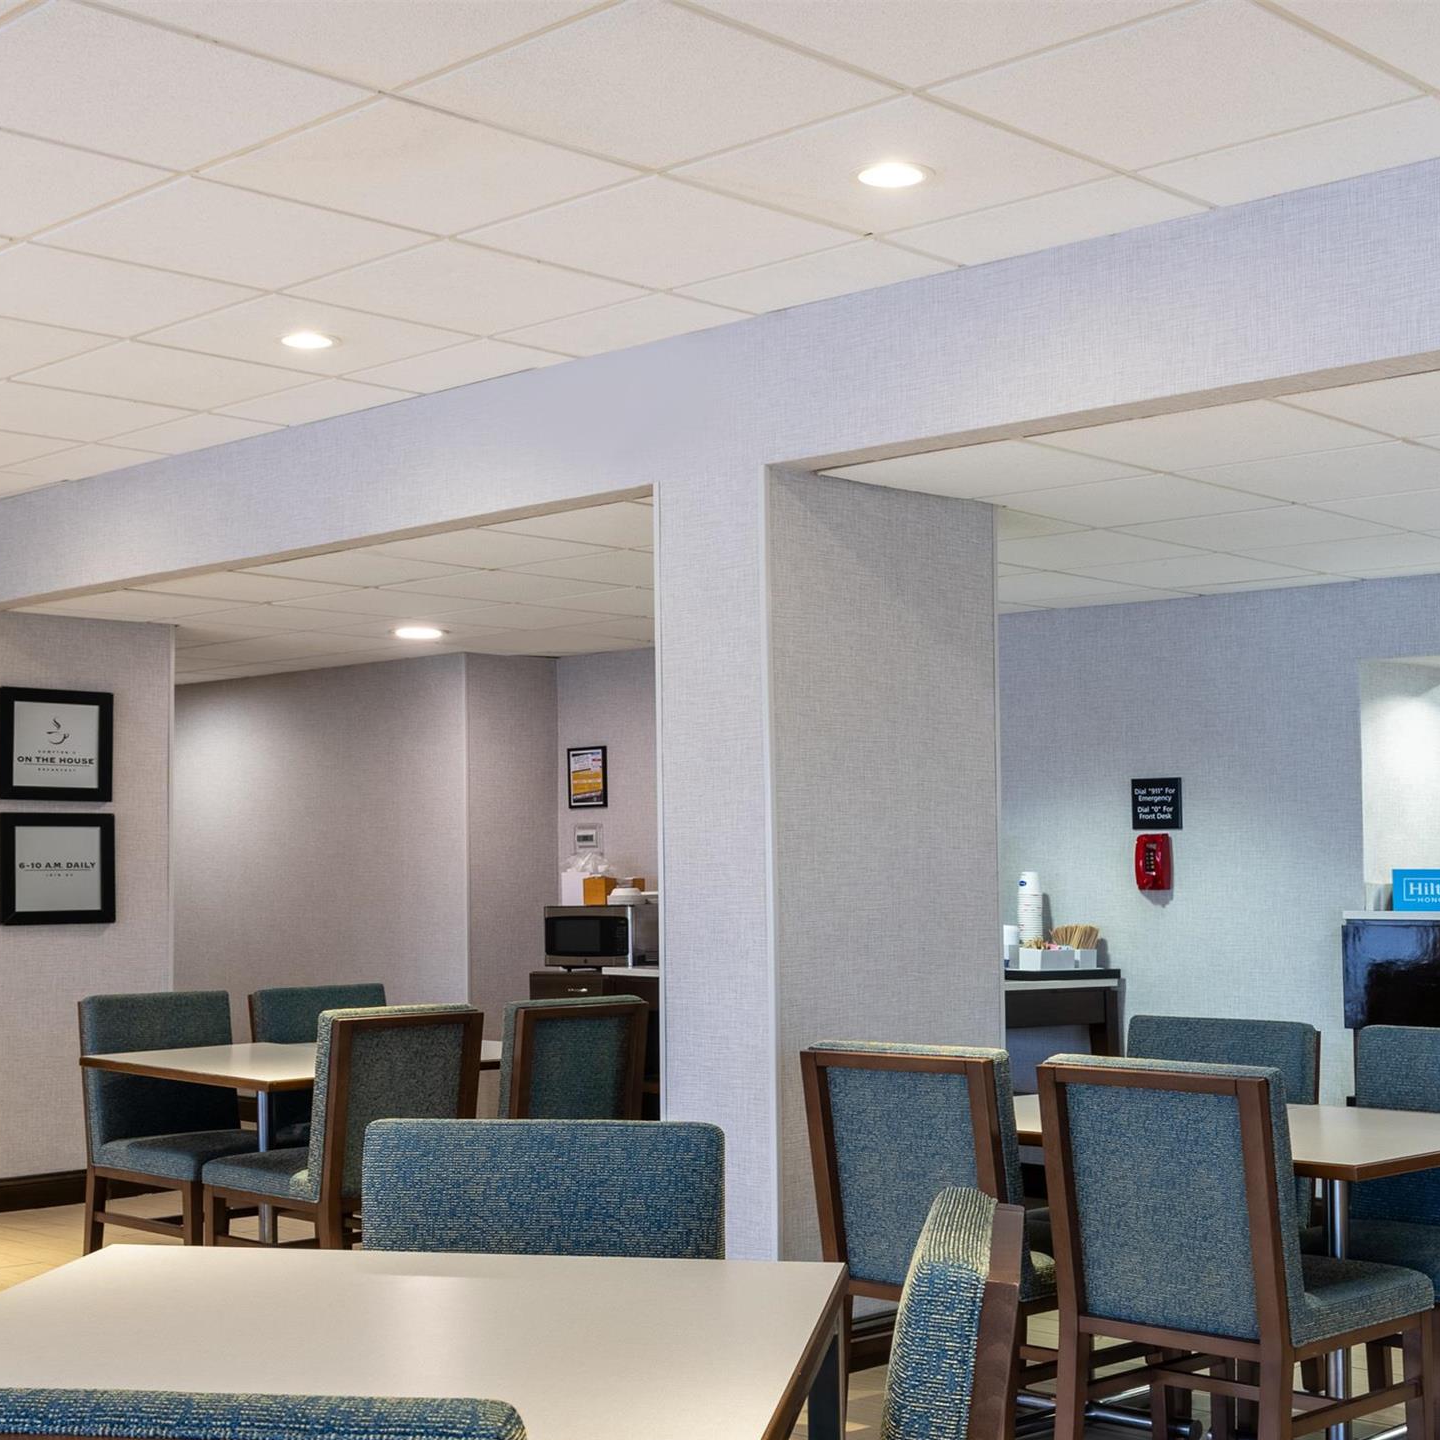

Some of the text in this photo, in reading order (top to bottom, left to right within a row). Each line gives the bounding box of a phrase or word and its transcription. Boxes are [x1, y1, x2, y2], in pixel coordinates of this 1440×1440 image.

[17, 755, 95, 765] ON THE HOUSE
[1139, 795, 1172, 803] Emergency
[1163, 805, 1174, 813] For
[19, 861, 42, 869] 6-10
[66, 861, 96, 869] DAILY
